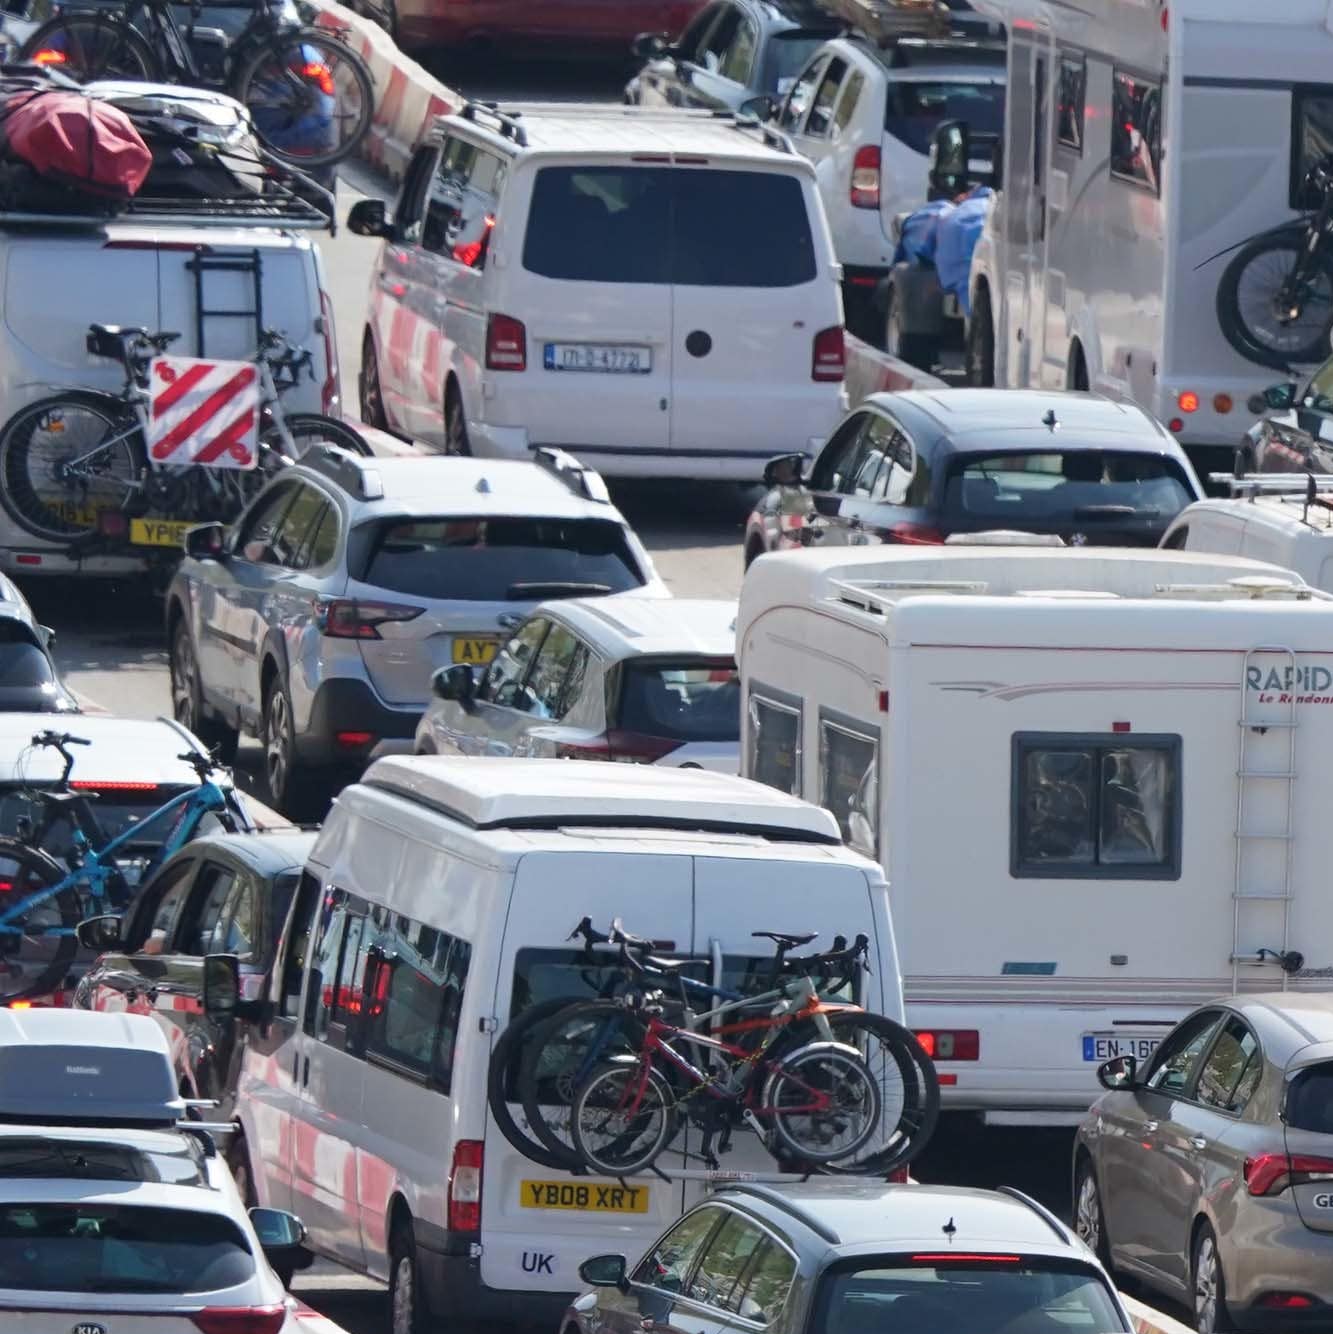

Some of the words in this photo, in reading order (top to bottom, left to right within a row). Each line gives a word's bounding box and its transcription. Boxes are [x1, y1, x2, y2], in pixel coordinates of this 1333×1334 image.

[1259, 693, 1273, 703] Le
[529, 1185, 590, 1209] YB08
[596, 1187, 642, 1211] XRT
[522, 1252, 556, 1275] UK
